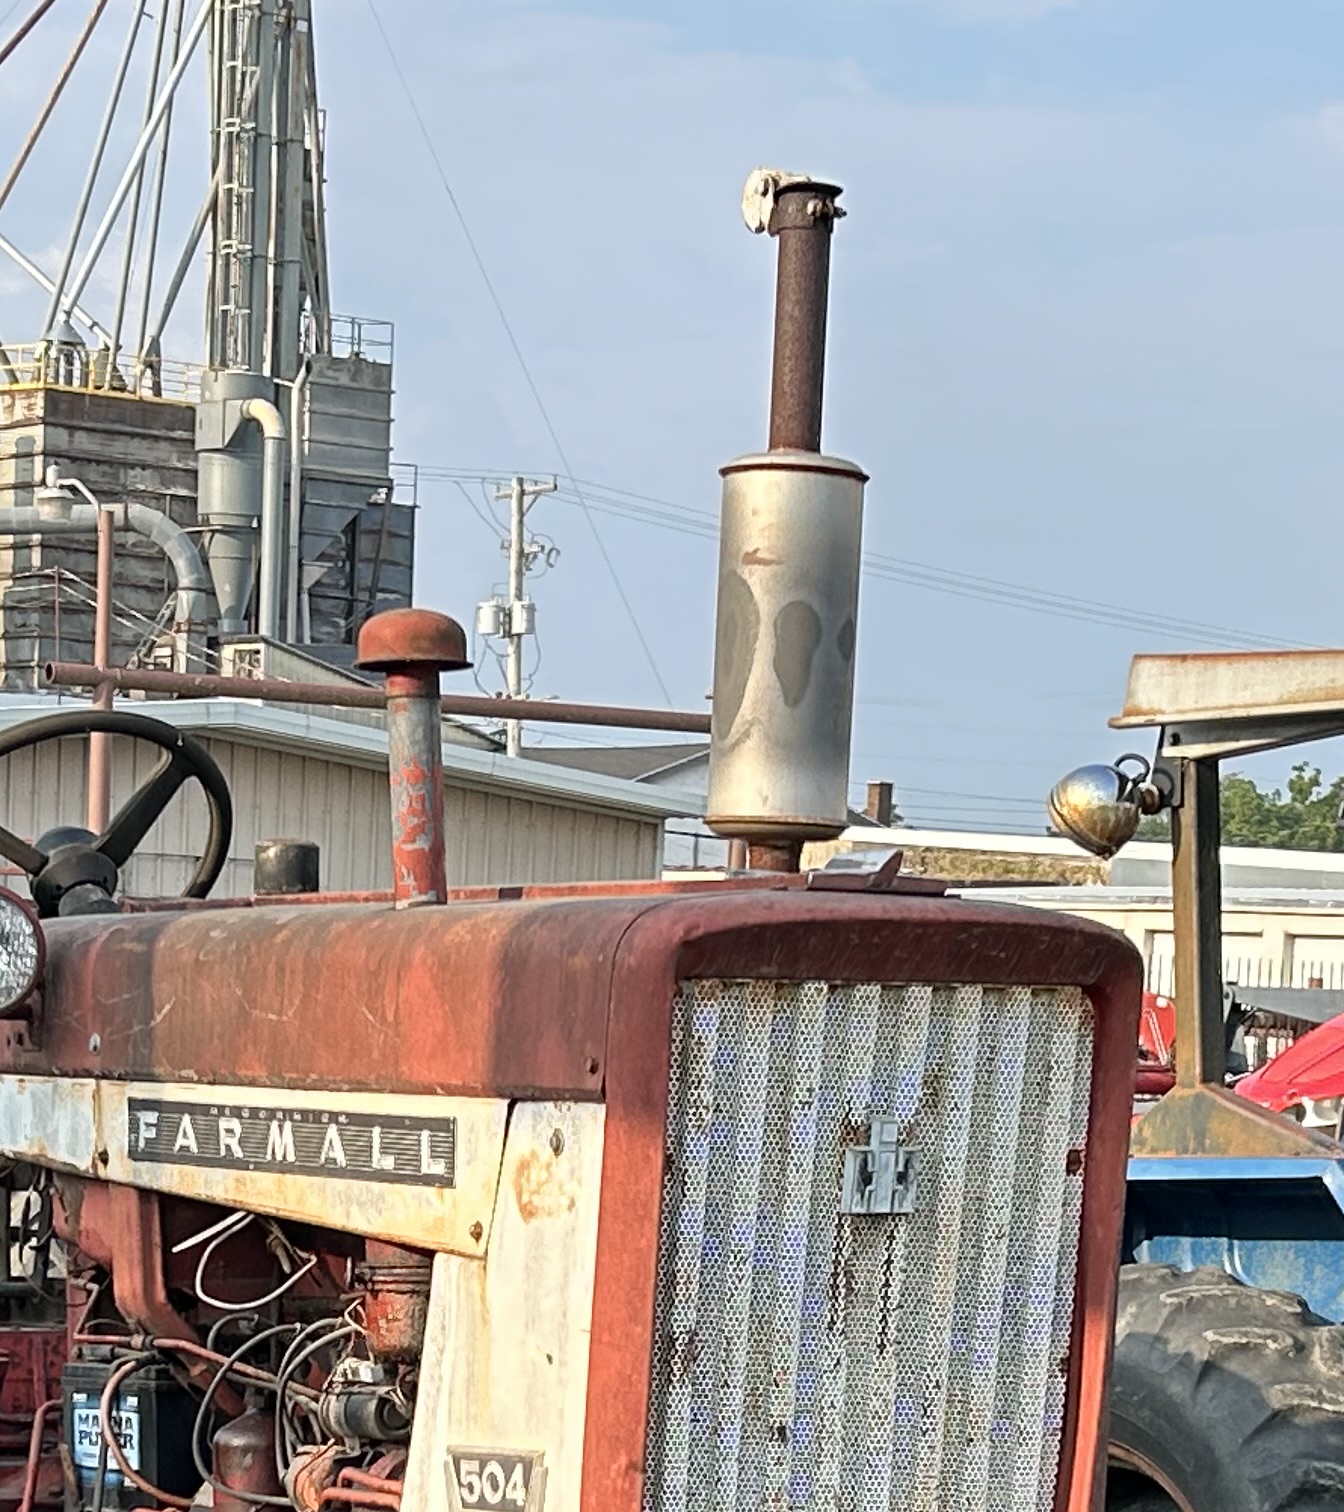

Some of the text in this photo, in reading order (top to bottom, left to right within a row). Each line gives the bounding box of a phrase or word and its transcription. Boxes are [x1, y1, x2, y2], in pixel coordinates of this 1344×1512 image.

[136, 1110, 447, 1175] FARMALL
[78, 1413, 135, 1432] MANA
[78, 1430, 135, 1450] POER
[459, 1458, 527, 1507] 504
